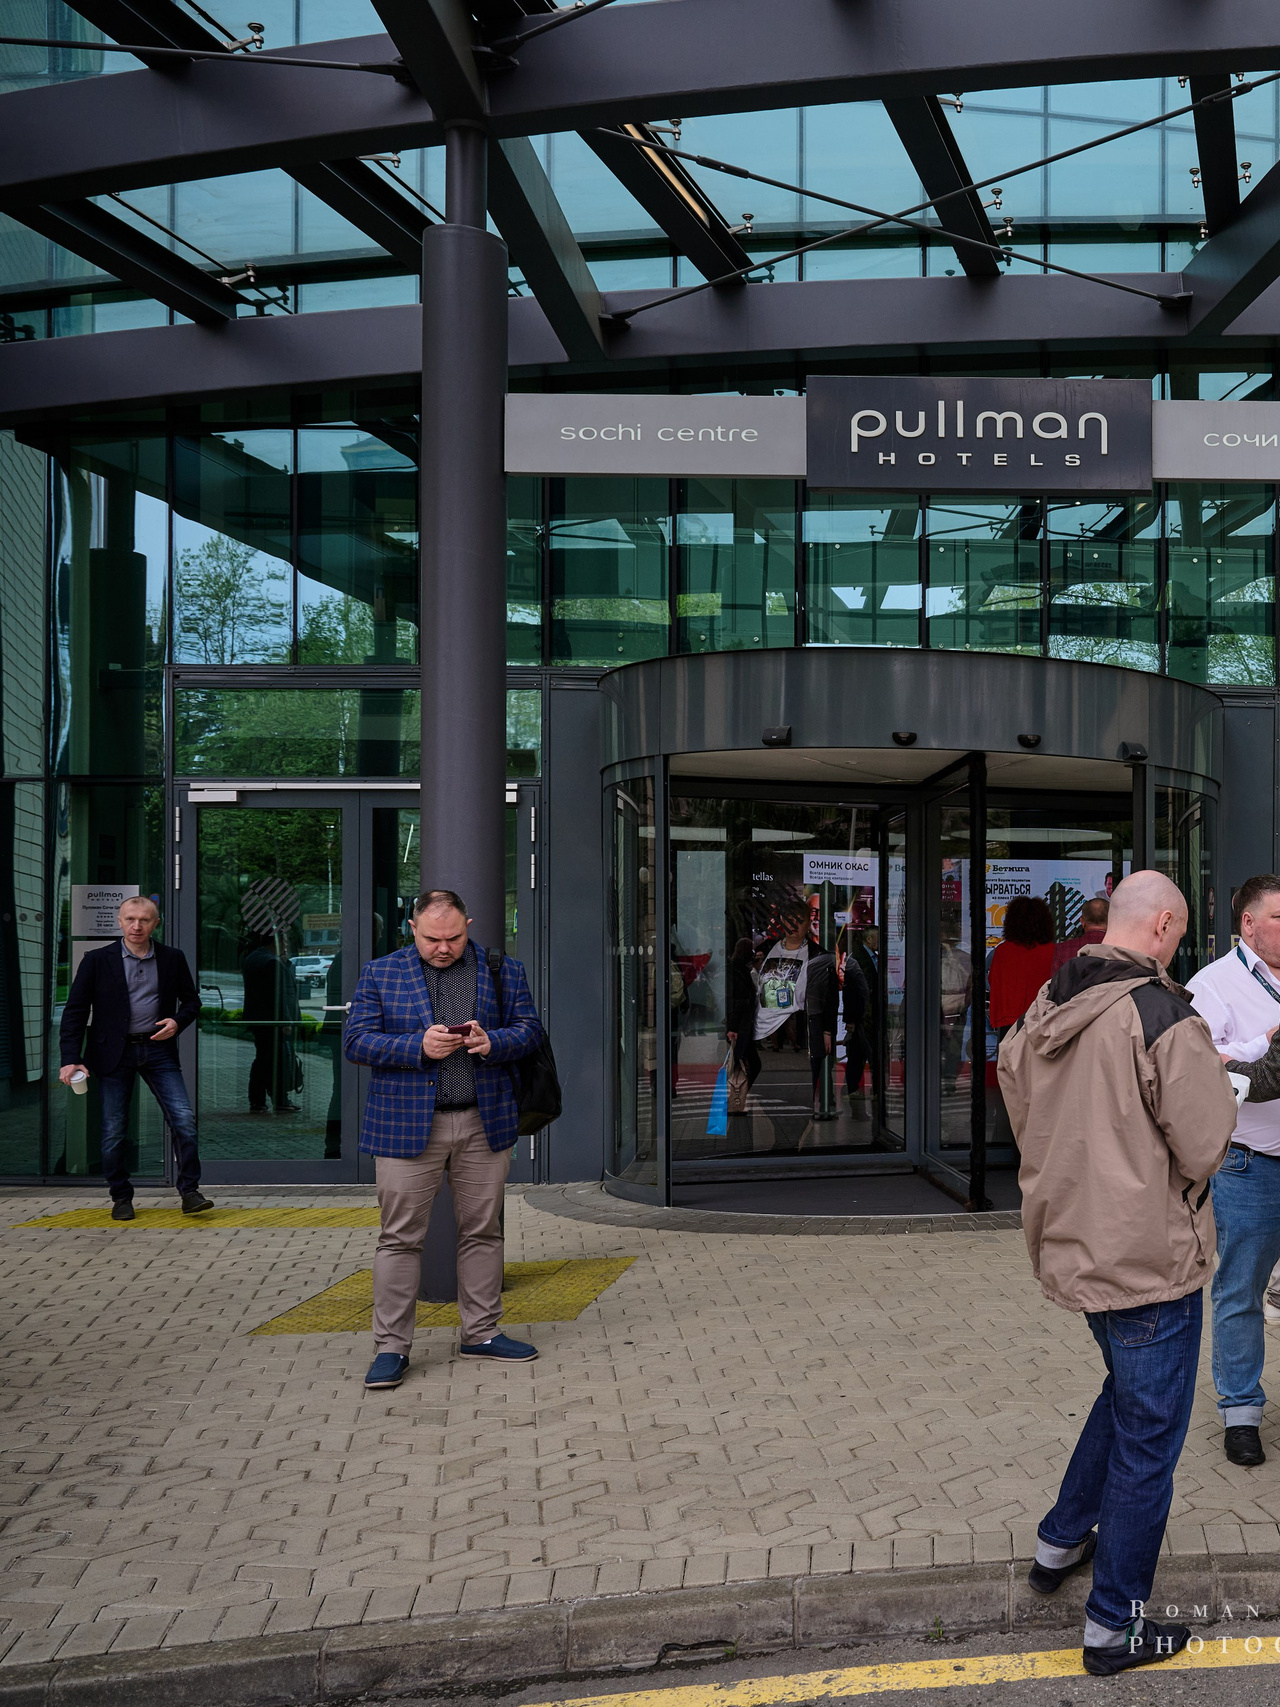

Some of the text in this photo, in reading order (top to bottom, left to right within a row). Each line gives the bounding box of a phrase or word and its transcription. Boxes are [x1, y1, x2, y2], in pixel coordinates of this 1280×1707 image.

[560, 423, 758, 442] sochi centre
[851, 400, 1108, 455] pullman
[1203, 433, 1278, 447] сочи
[878, 452, 1081, 466] HOTELS
[809, 860, 869, 872] ОМНИК ОКАС
[752, 872, 774, 881] tellas
[87, 891, 123, 899] pullman
[985, 883, 1031, 895] ЫРВАТЬСЯ
